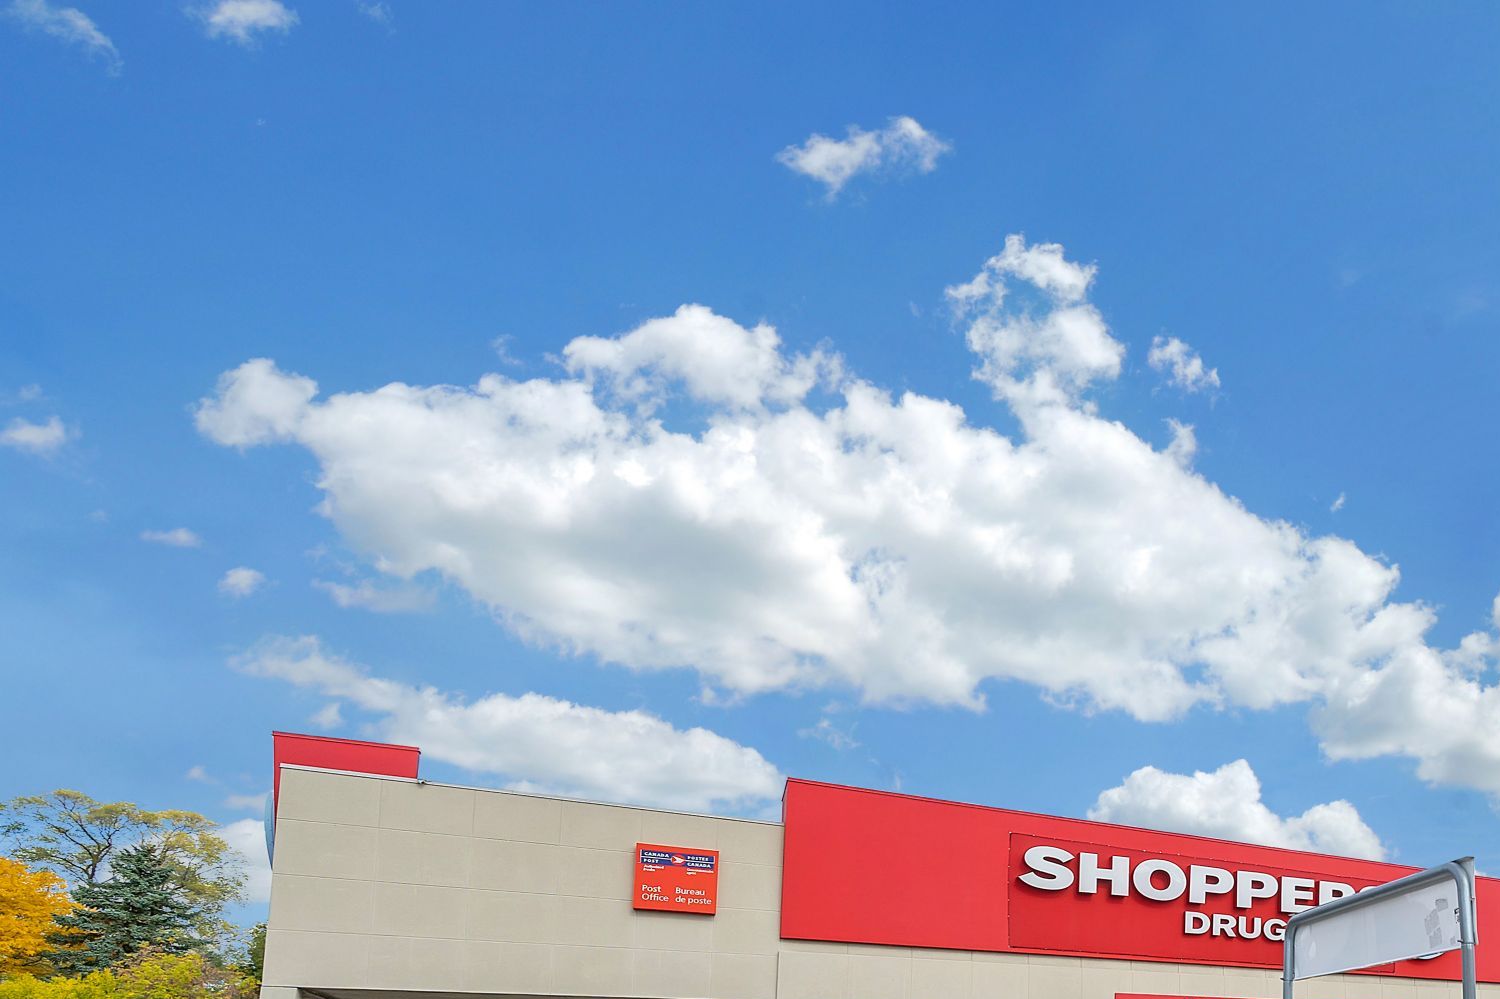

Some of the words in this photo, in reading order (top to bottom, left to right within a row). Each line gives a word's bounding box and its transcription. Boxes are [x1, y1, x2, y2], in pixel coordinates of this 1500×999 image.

[1018, 846, 1378, 913] SHOPPER
[642, 884, 662, 893] Post
[675, 887, 705, 896] Bureau
[641, 893, 669, 902] Office
[687, 897, 712, 905] poste
